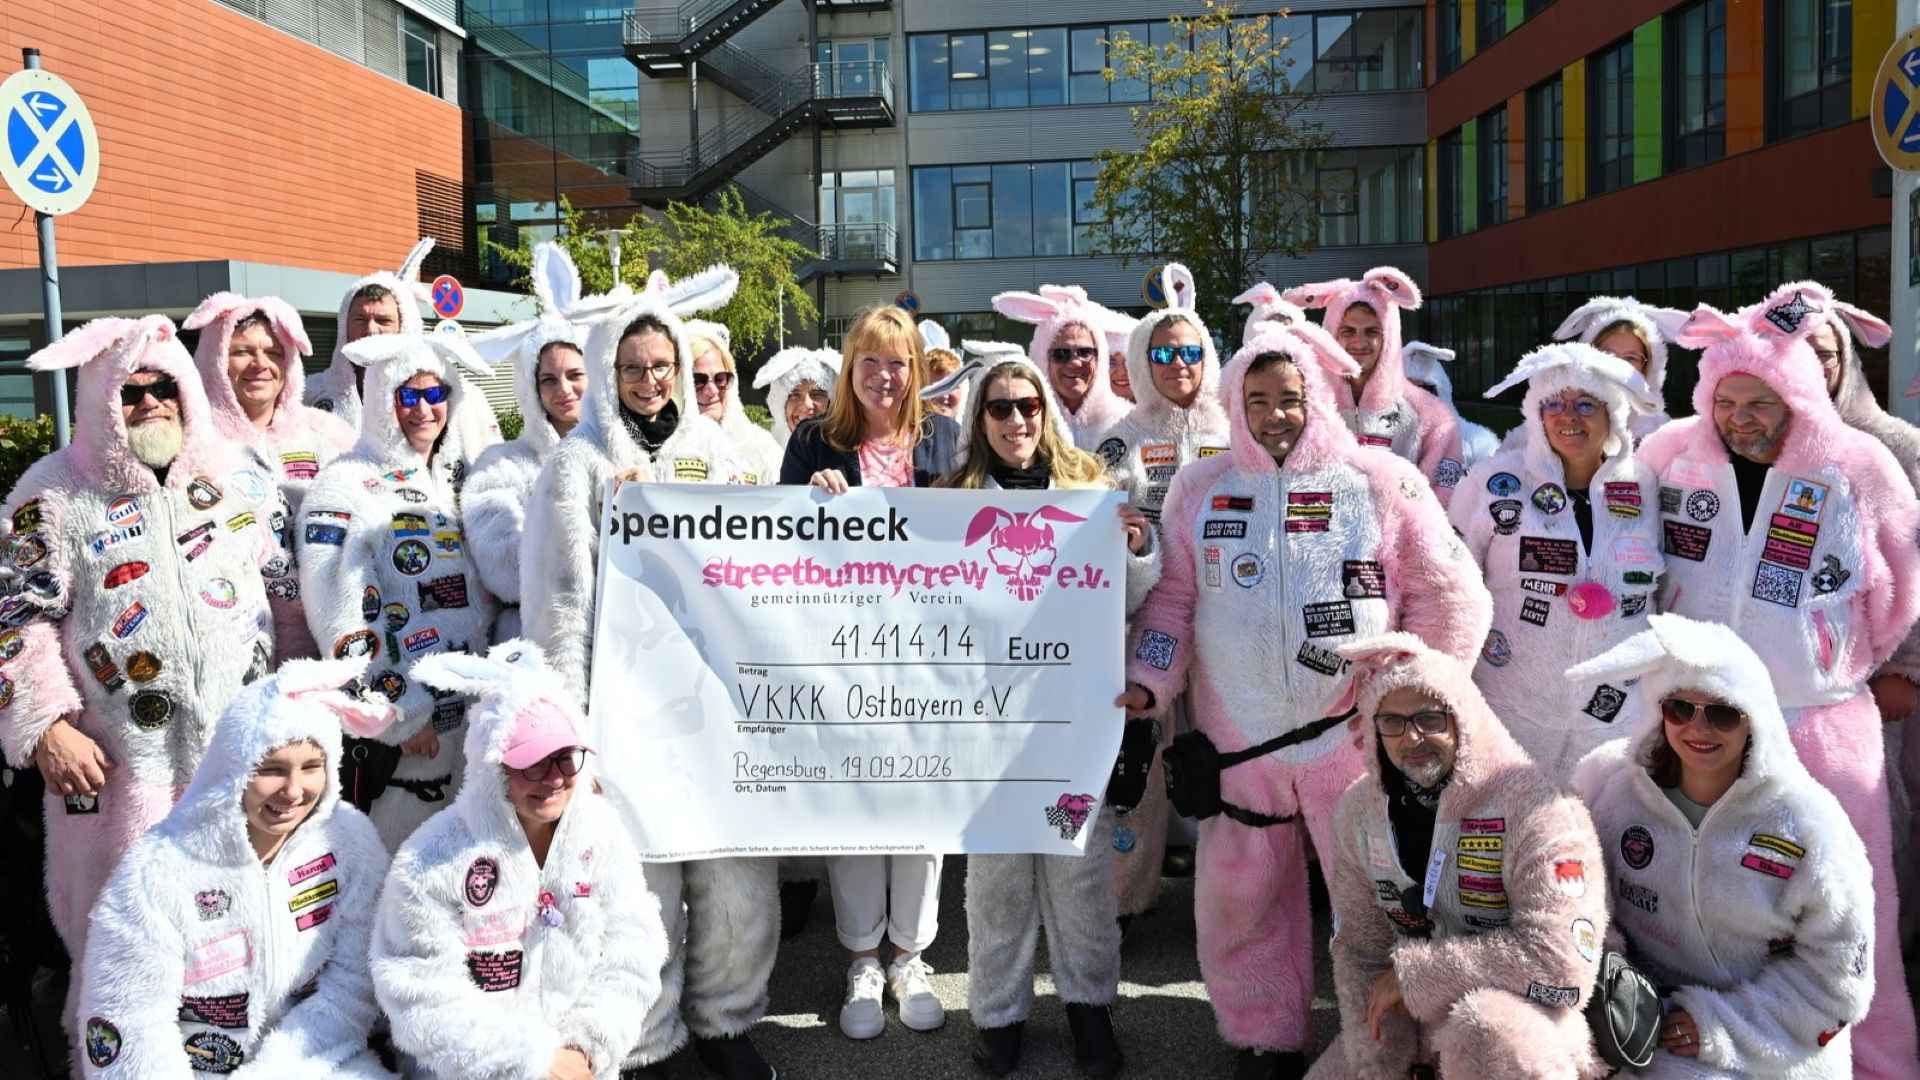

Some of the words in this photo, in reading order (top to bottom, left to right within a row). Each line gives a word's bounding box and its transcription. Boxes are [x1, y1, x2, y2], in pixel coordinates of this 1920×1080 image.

[109, 502, 140, 523] Gulf
[702, 556, 988, 597] streetbunnycrew
[1524, 580, 1557, 595] MEHR
[751, 591, 882, 607] gemeinnütziger
[909, 591, 962, 604] Verein
[119, 609, 148, 638] ANTENNE
[1307, 610, 1351, 623] NERVLICH
[407, 638, 439, 652] ANTENNE
[408, 631, 432, 645] ROCK
[831, 623, 974, 659] 41.414,14
[1009, 637, 1070, 660] Euro
[738, 666, 768, 677] Betrag
[738, 683, 826, 720] VKKK
[847, 684, 963, 720] Ostbayern
[974, 686, 1012, 717] e.V.
[737, 724, 786, 734] Empfänger
[841, 755, 952, 778] 19.09.2026
[735, 784, 753, 793] Ort,
[755, 784, 787, 793] Datum
